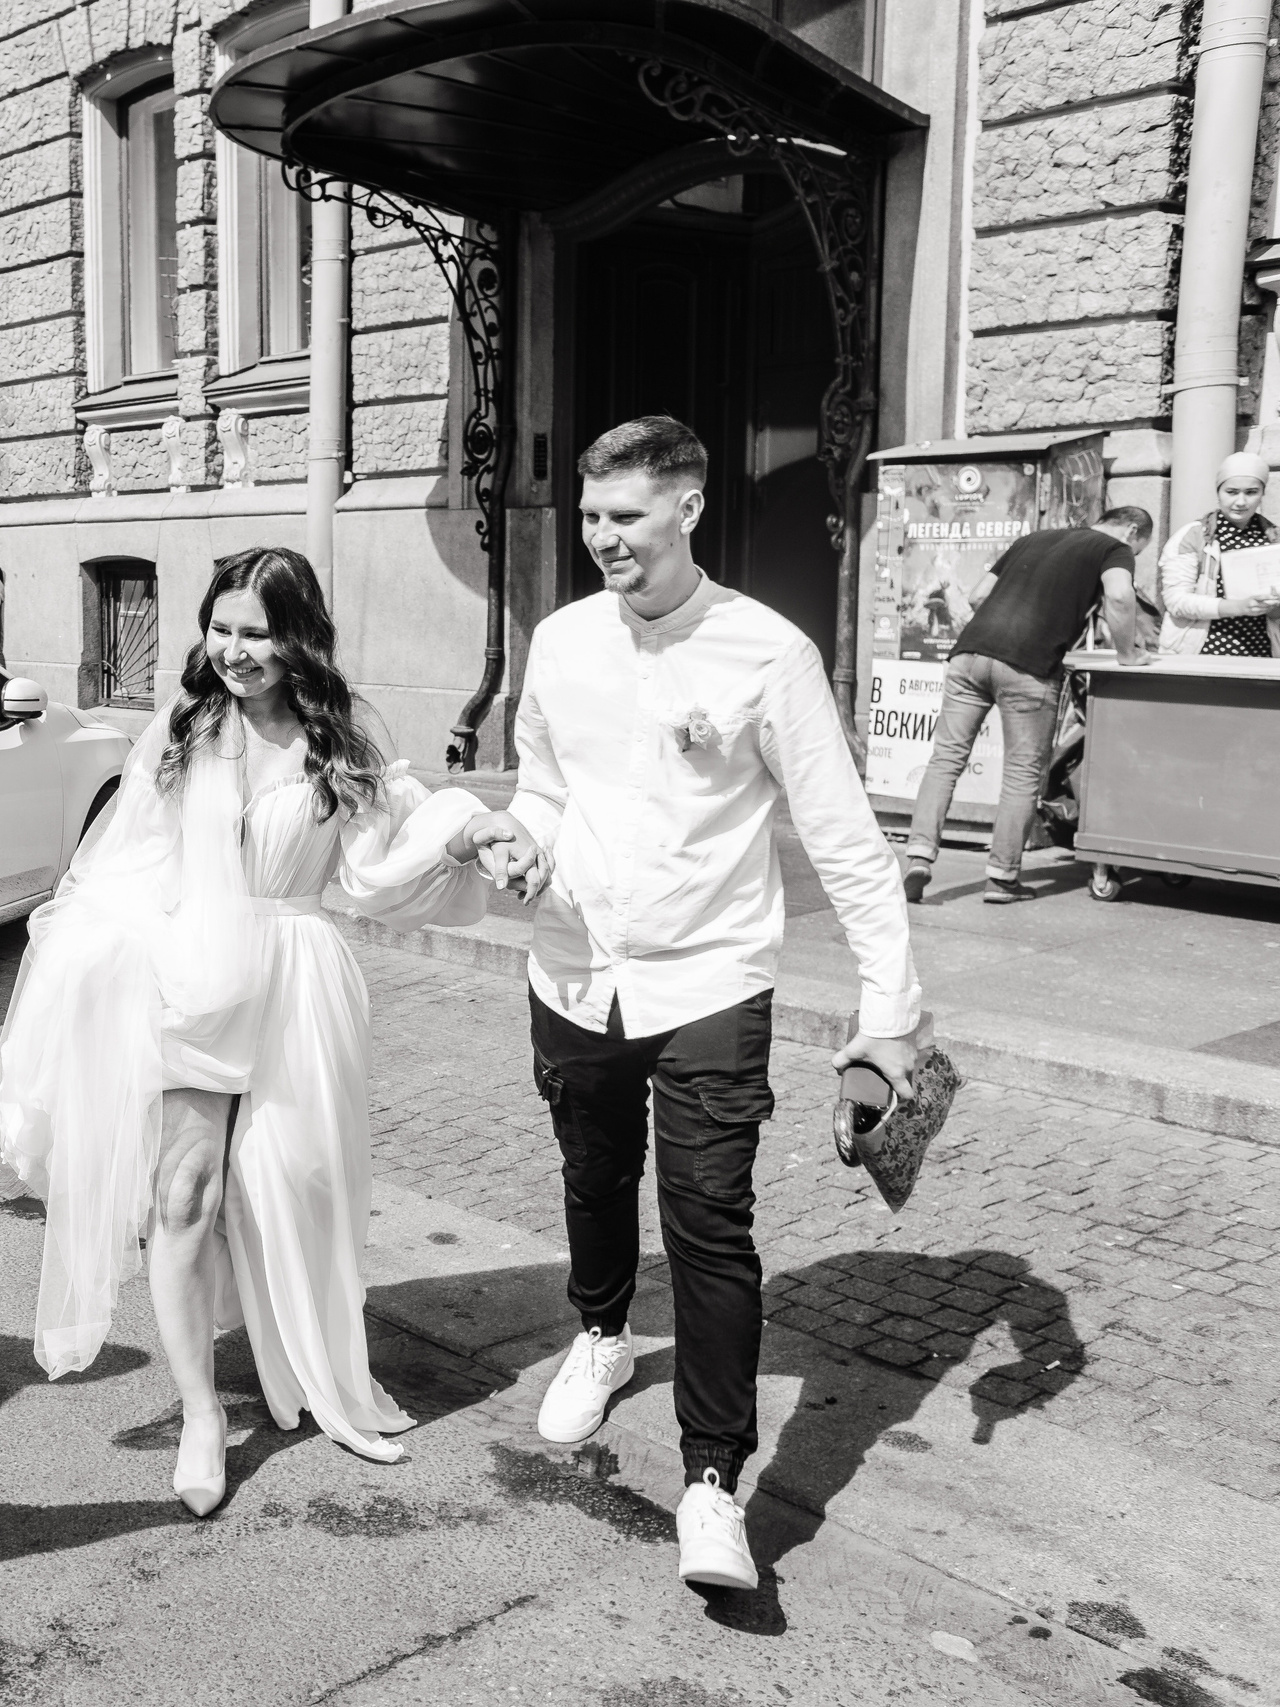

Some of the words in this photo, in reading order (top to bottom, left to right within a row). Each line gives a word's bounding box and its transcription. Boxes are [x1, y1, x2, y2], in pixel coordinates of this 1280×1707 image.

[907, 522, 971, 538] ЛЕГЕНДА
[976, 520, 1031, 537] СЕВЕРА
[899, 678, 907, 695] 6
